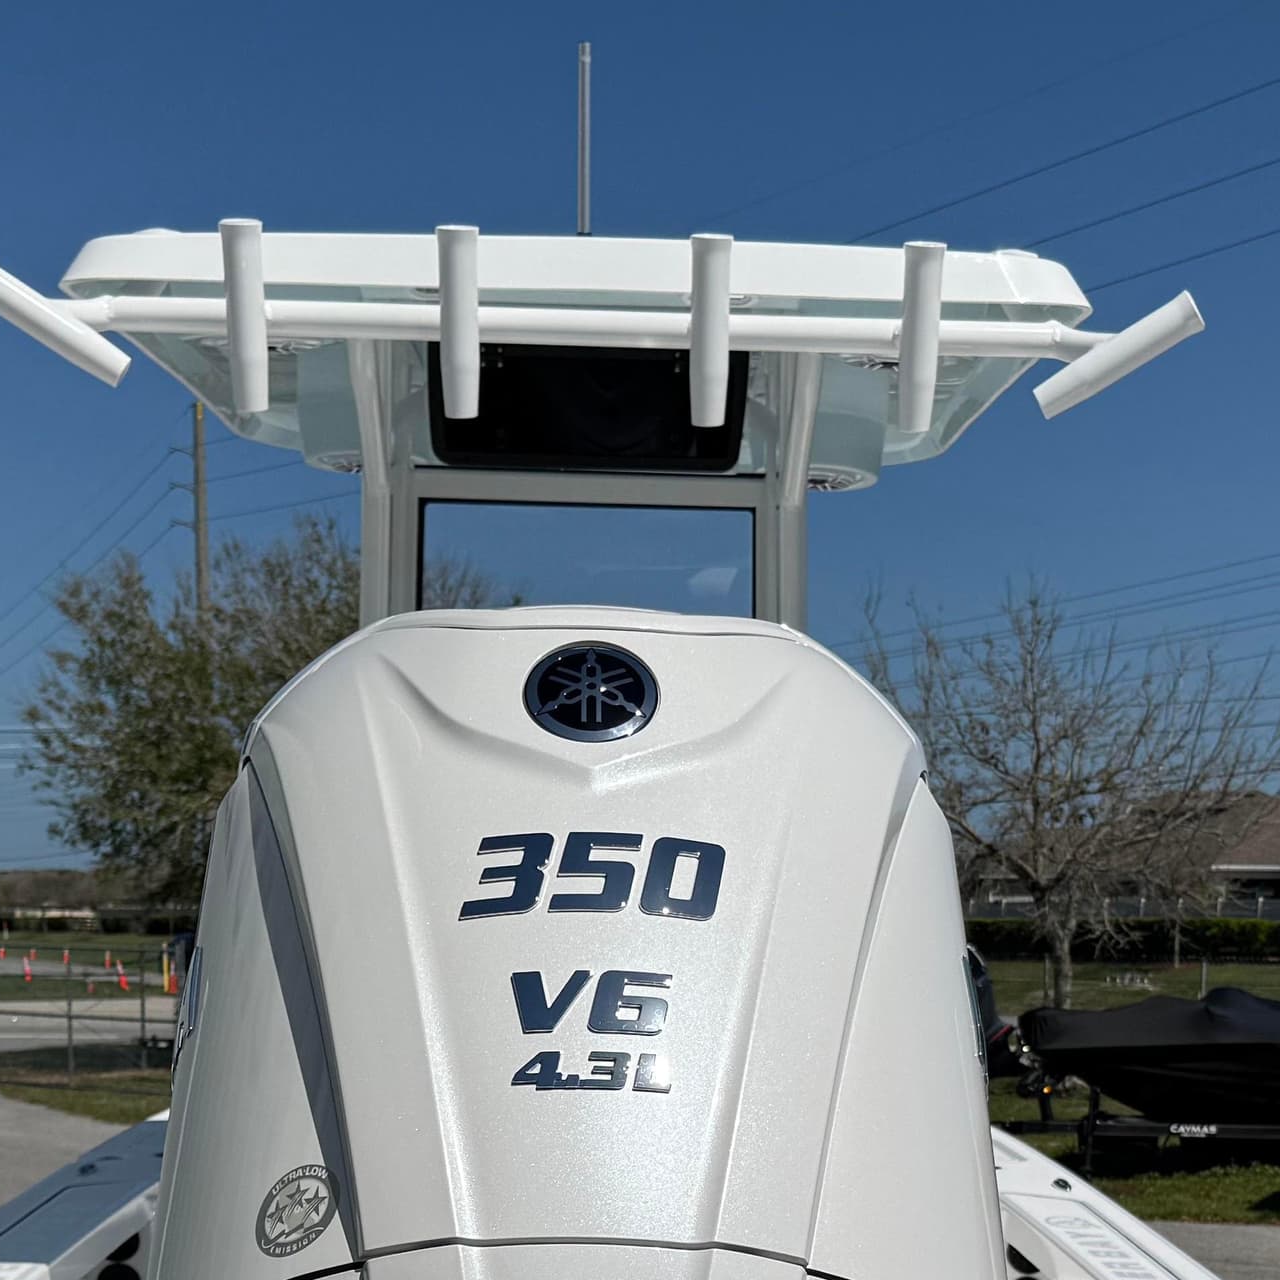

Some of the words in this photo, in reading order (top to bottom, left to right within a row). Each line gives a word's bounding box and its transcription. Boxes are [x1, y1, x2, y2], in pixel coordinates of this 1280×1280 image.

[458, 831, 726, 921] 350
[510, 970, 673, 1036] V6
[511, 1051, 672, 1094] 4.3L
[1169, 1123, 1217, 1134] CAYMAS
